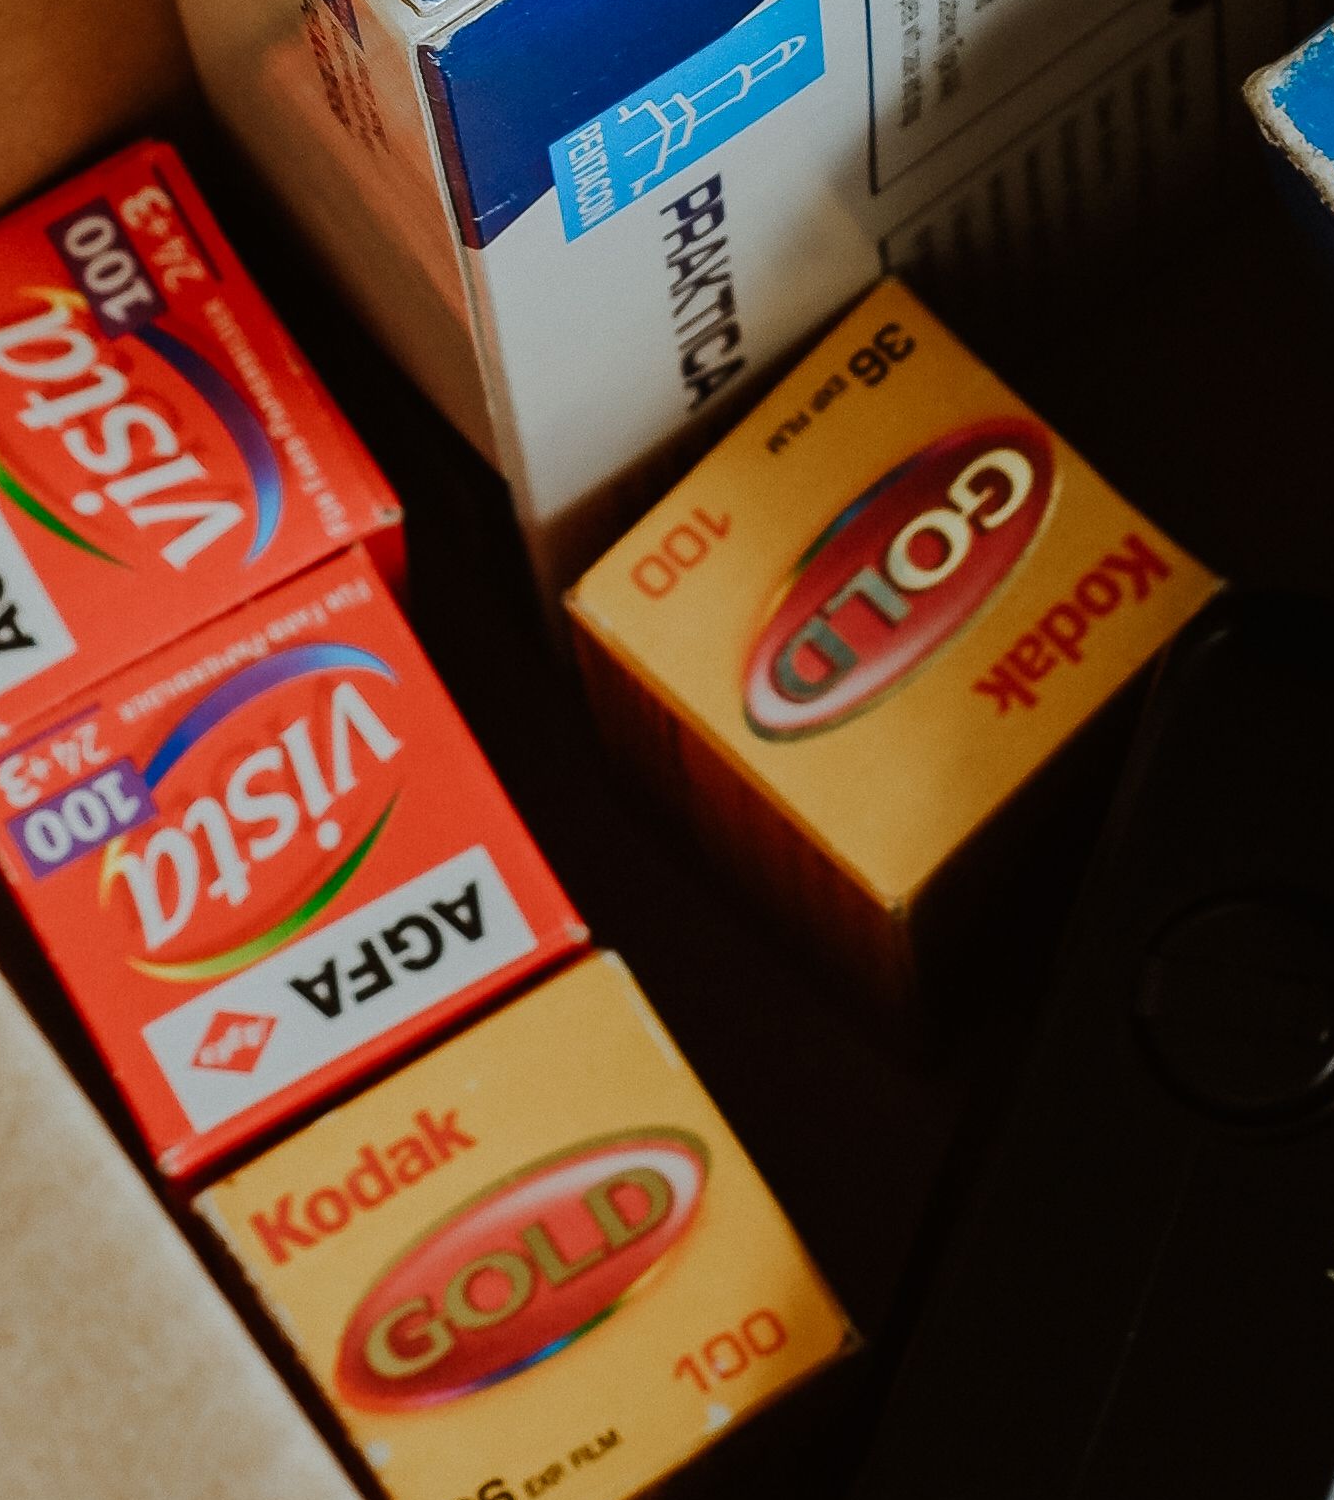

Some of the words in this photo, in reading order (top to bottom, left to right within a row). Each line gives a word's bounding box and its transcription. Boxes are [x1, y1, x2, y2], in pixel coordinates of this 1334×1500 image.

[566, 121, 615, 230] PENTACON
[64, 213, 157, 324] 100
[660, 171, 747, 409] PRAKTICA
[847, 320, 918, 388] 36
[629, 504, 733, 602] 100
[771, 446, 1035, 702] GOLD
[974, 531, 1173, 718] Kodak
[22, 768, 144, 865] 100
[119, 680, 404, 952] vista
[289, 881, 487, 1020] AGFA
[248, 1105, 478, 1265] Kodak
[365, 1164, 676, 1380] GOLD
[673, 1308, 788, 1397] 100
[571, 1427, 623, 1472] FILM
